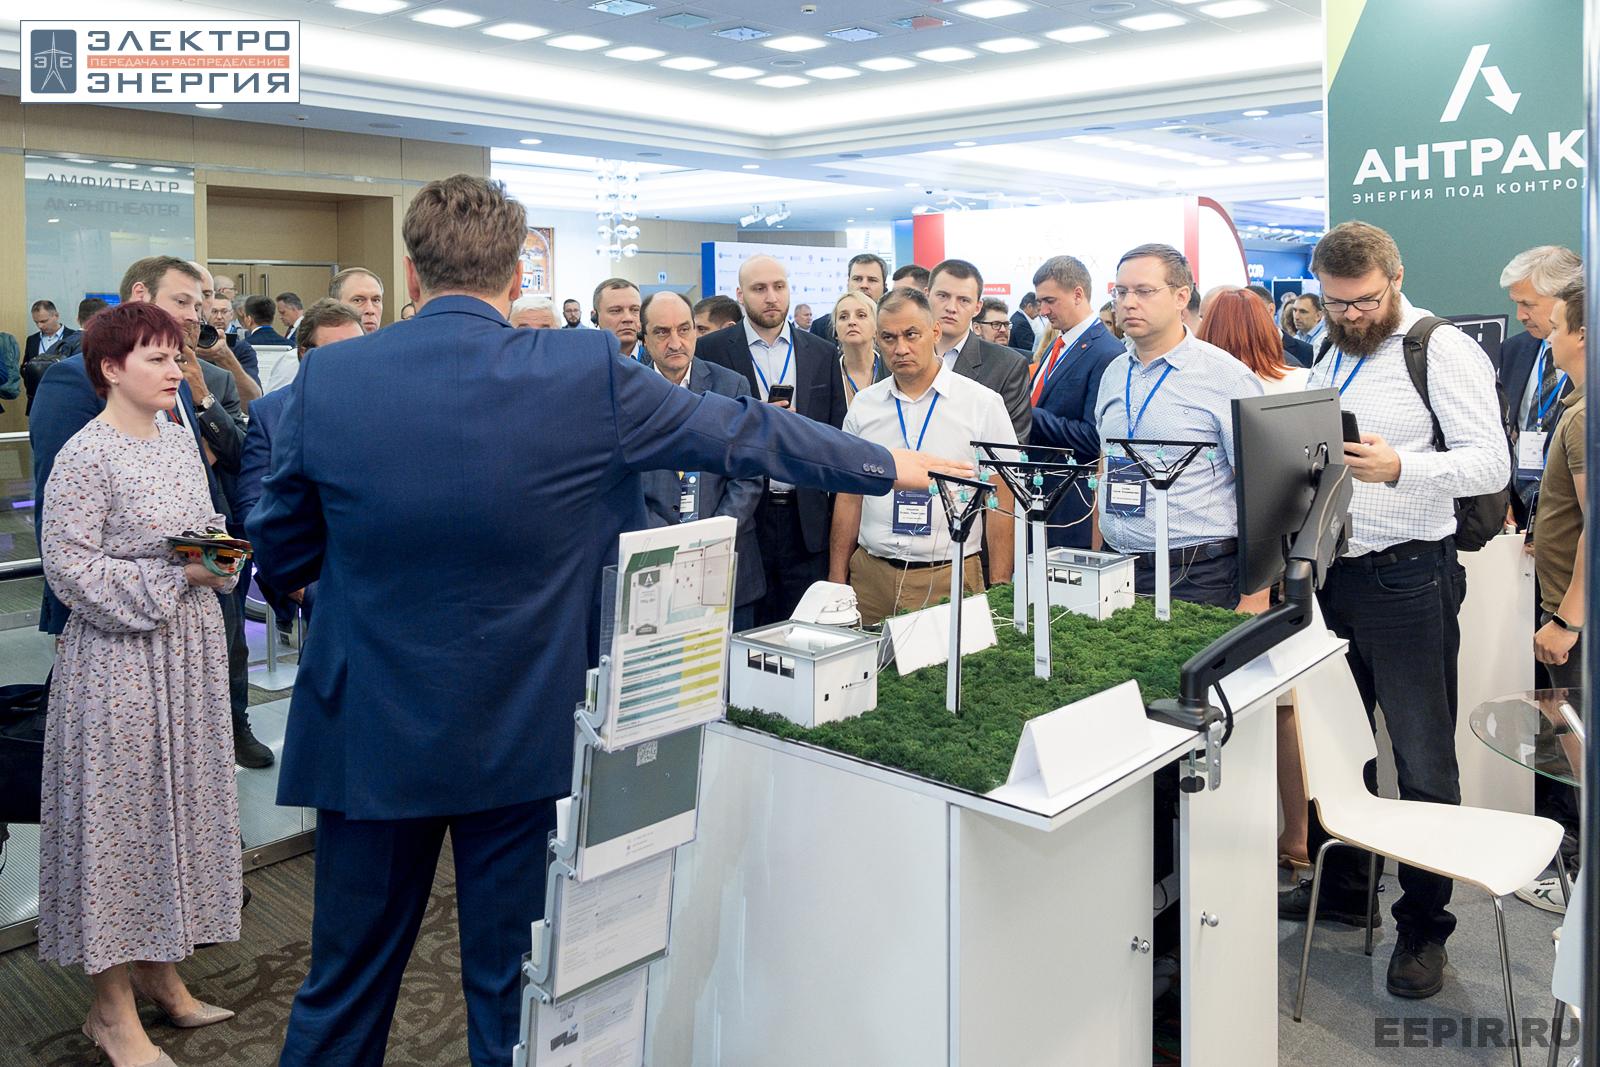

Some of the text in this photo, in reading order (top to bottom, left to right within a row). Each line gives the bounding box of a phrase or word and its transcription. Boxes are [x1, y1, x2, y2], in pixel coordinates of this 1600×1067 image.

[45, 172, 180, 194] АМФИТЕАТР
[1352, 188, 1434, 204] ЭНЕРГИЯ
[1445, 184, 1485, 198] ПОД
